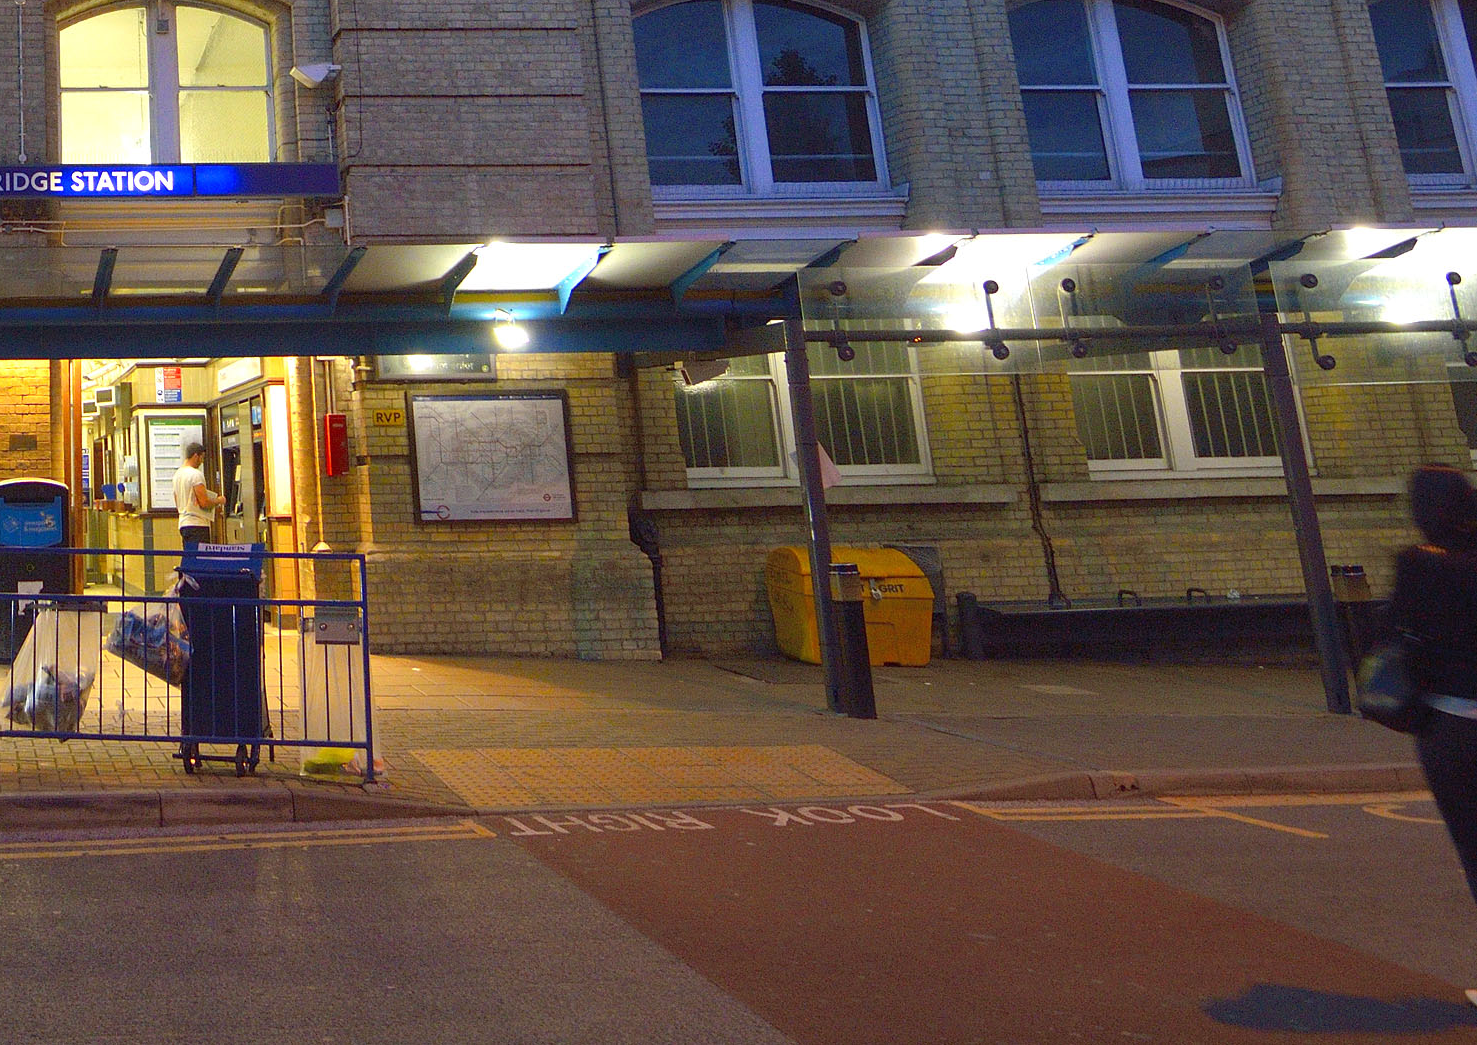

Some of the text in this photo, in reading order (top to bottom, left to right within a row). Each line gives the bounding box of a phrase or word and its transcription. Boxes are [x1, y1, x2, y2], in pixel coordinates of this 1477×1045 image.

[70, 170, 174, 192] STATION
[375, 412, 401, 423] RVP
[878, 583, 904, 593] GRIT
[510, 802, 962, 836] LOOK RIGHT
